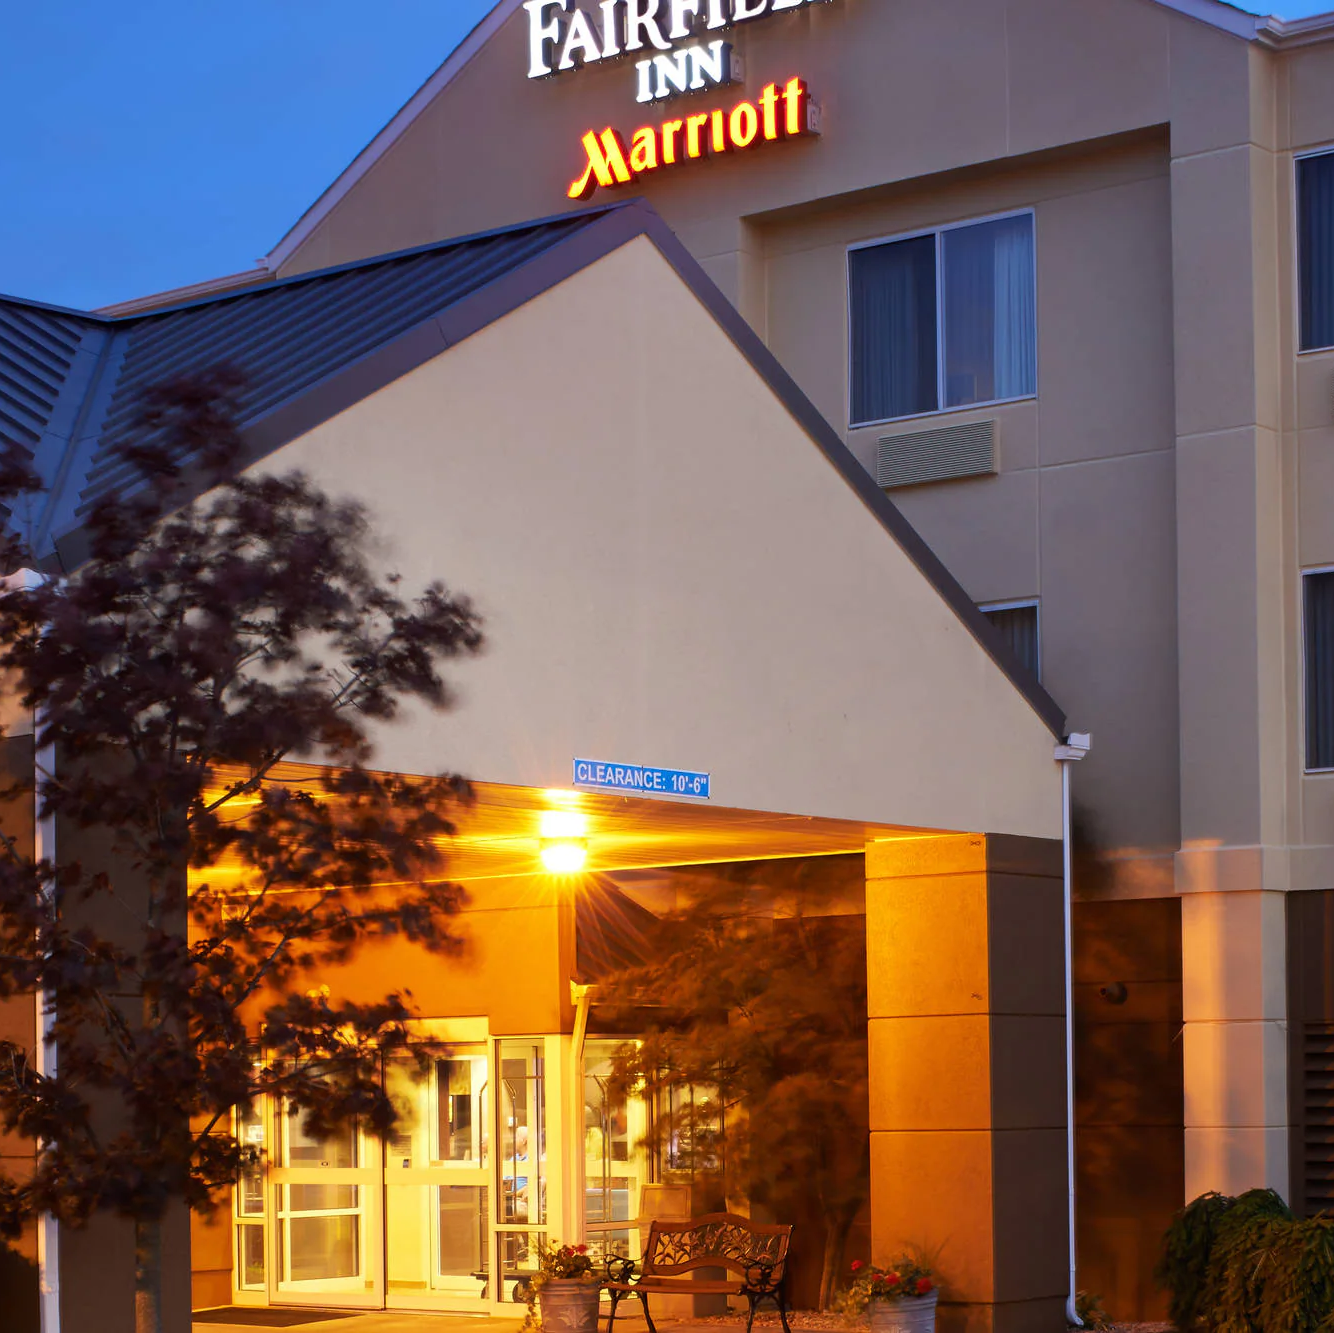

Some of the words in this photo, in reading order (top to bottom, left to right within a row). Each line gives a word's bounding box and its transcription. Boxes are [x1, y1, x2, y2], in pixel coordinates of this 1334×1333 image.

[636, 40, 724, 102] INN
[567, 76, 803, 200] Marriott
[577, 763, 666, 789] CLEARANCE:
[671, 774, 707, 793] 10'-6"
